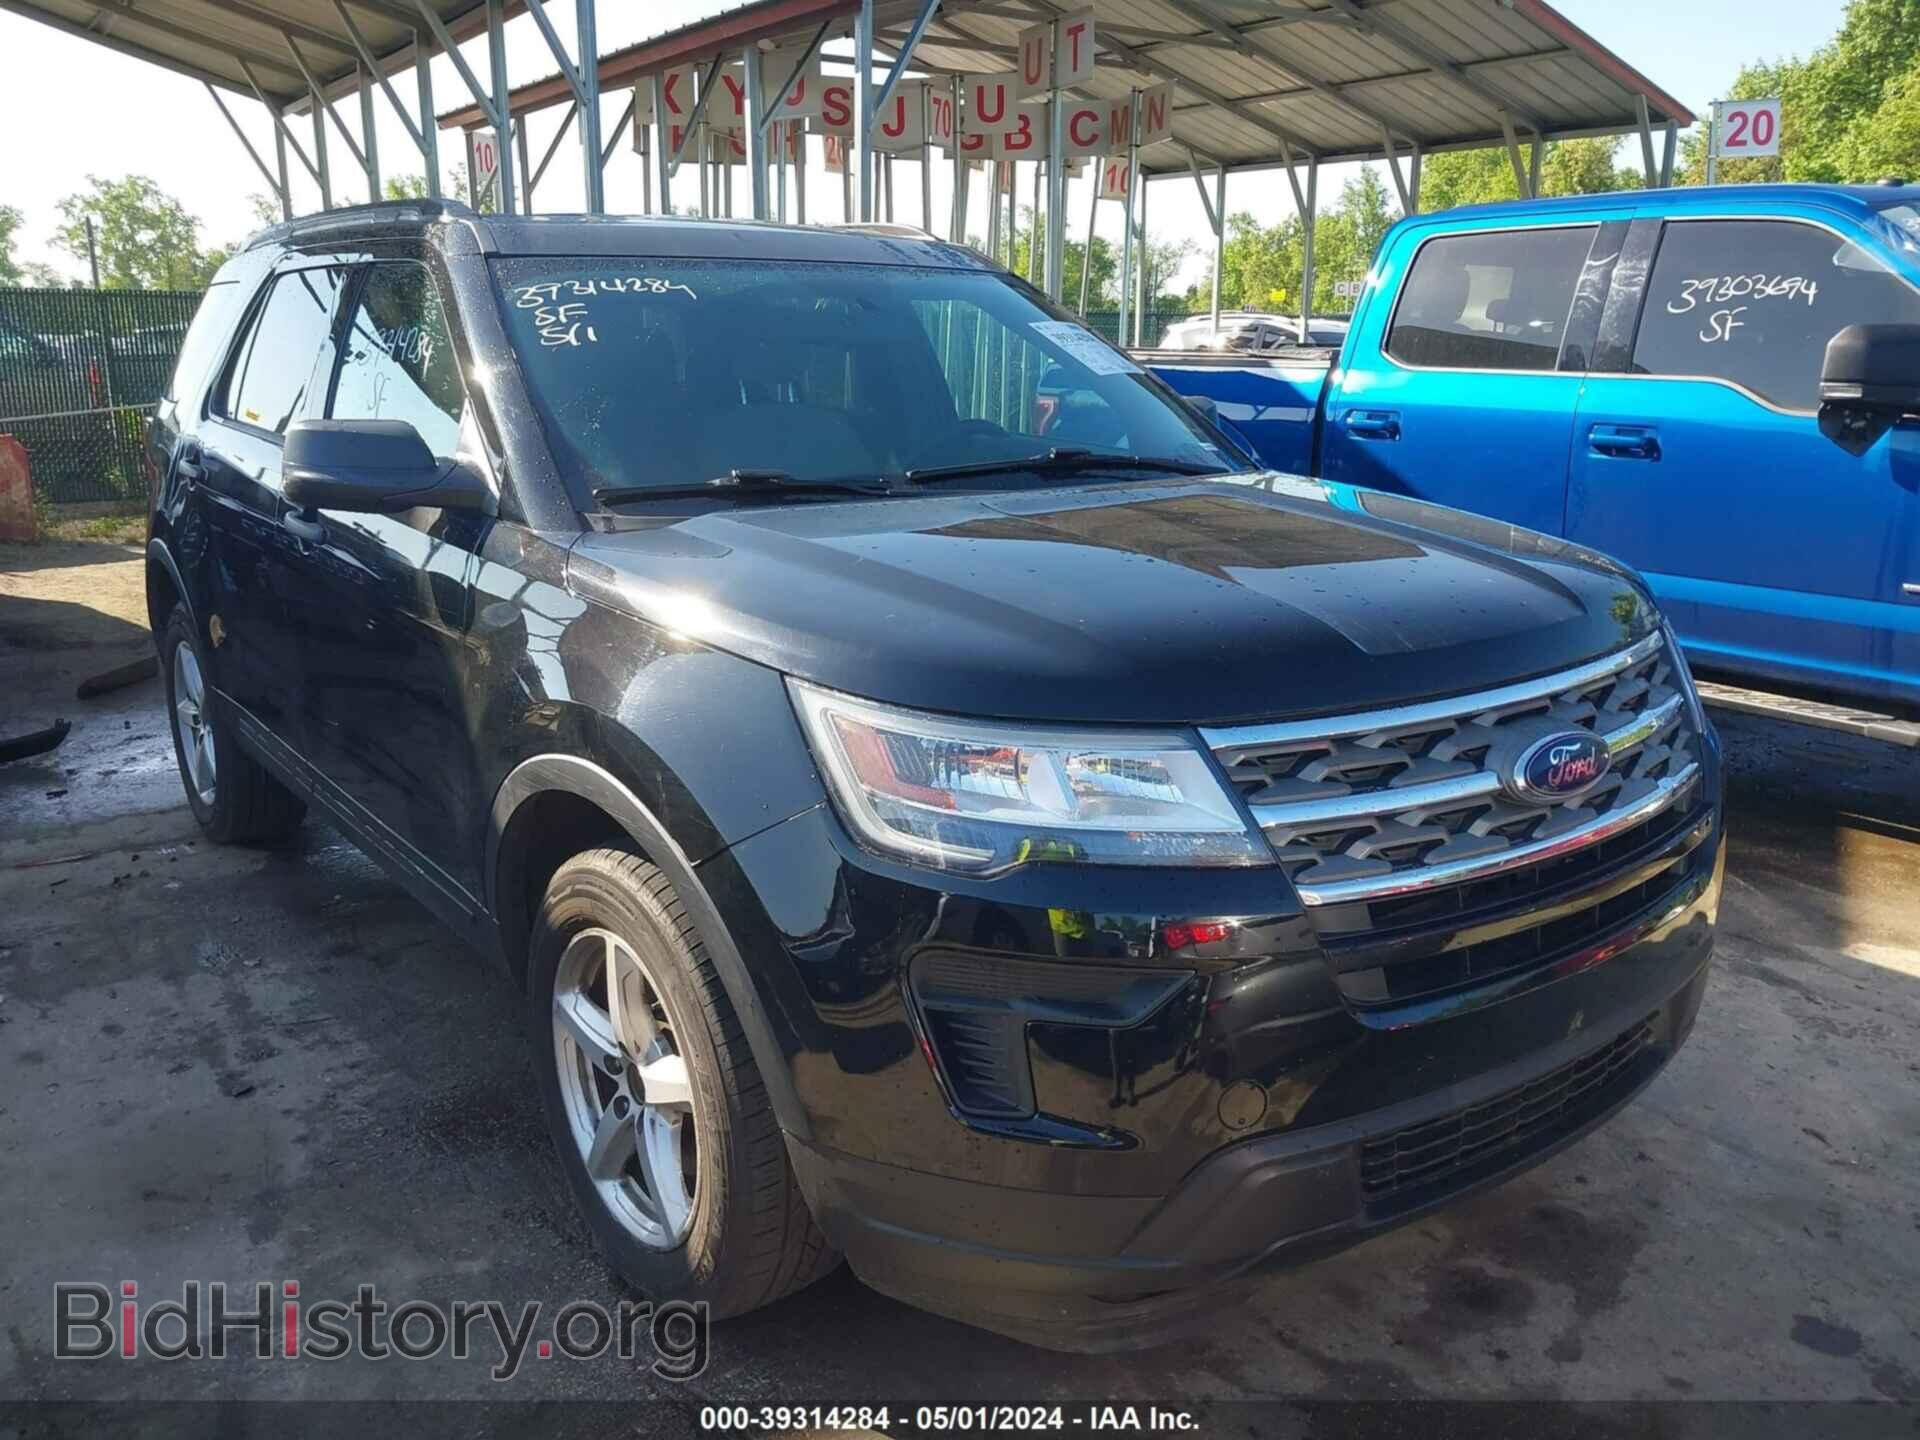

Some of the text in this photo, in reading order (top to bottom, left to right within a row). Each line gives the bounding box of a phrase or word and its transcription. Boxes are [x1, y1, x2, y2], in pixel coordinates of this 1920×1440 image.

[1024, 38, 1042, 85] U
[1067, 23, 1085, 72] T
[722, 75, 744, 115] Y
[822, 87, 850, 126] S
[977, 85, 1005, 123] U
[1147, 94, 1165, 134] N
[882, 96, 905, 137] J
[933, 97, 952, 138] 70
[1004, 113, 1033, 151] B
[1070, 110, 1099, 147] C
[1726, 110, 1774, 147] 20
[476, 142, 493, 173] 10
[1667, 274, 1818, 314] 39303694
[535, 303, 588, 326] SF
[1700, 306, 1748, 342] SF
[1548, 742, 1598, 787] Ford
